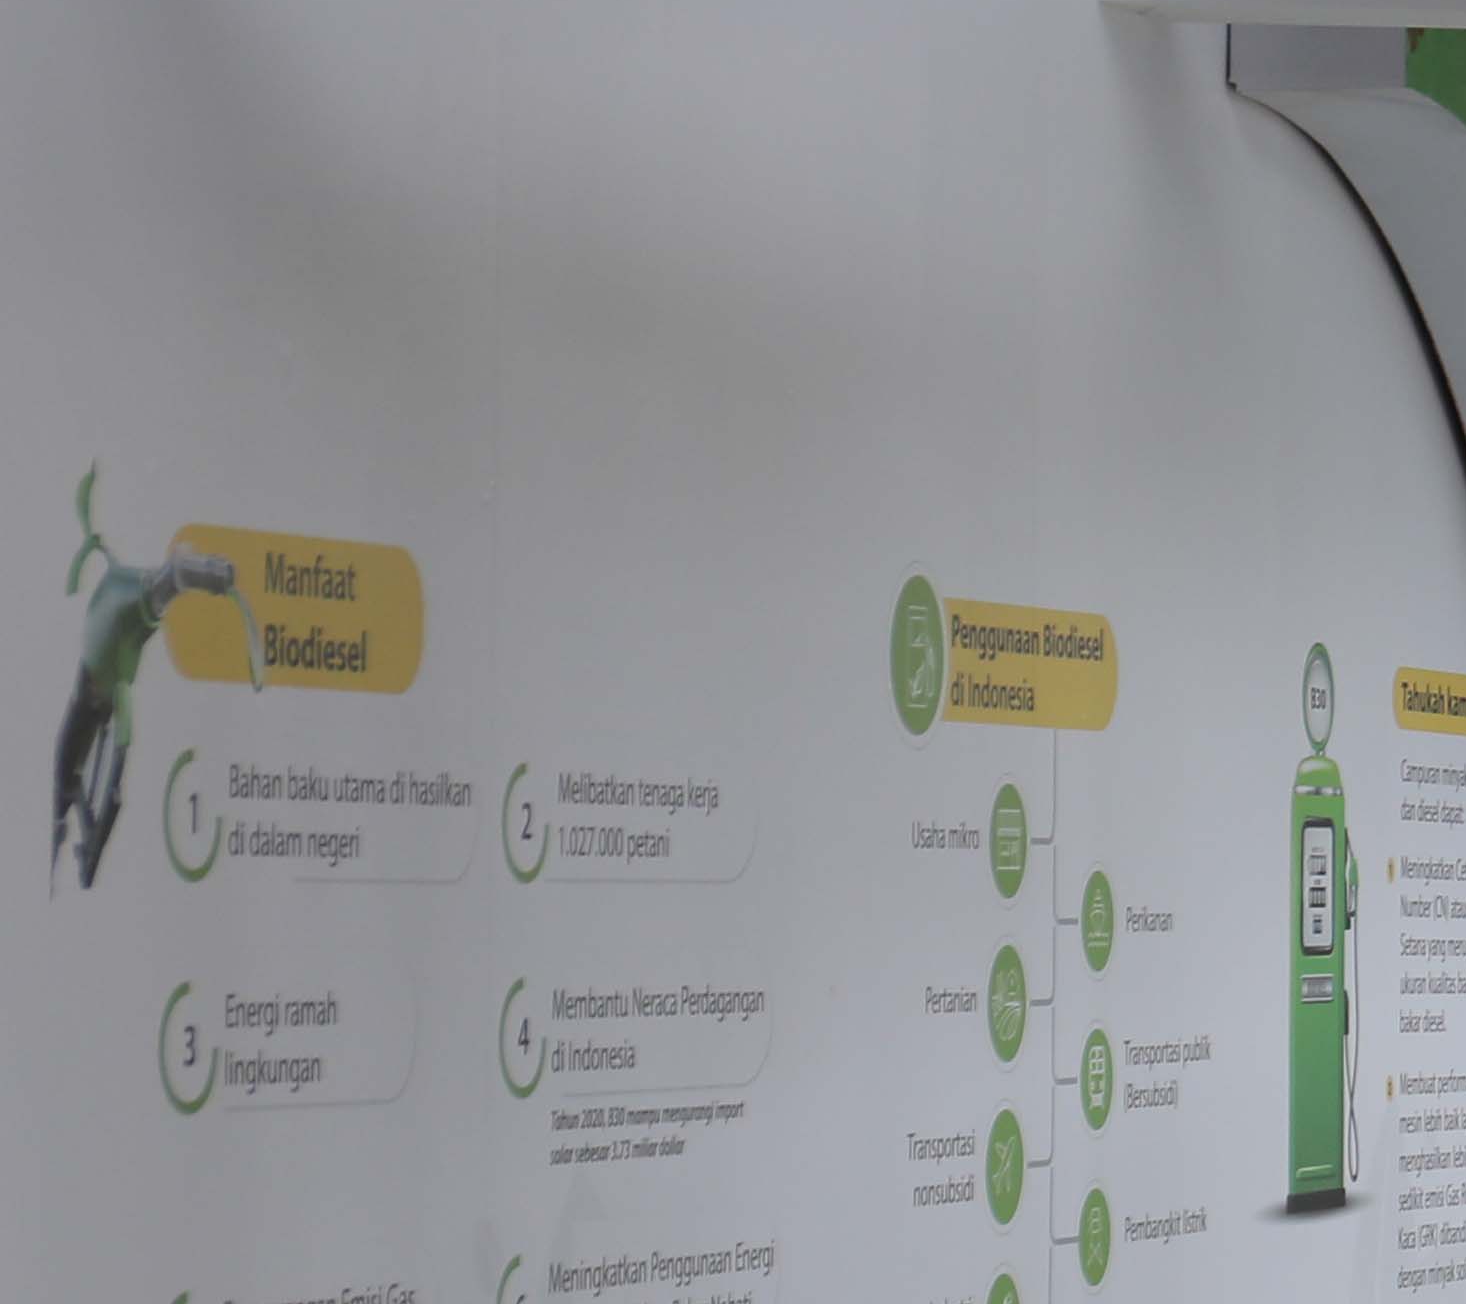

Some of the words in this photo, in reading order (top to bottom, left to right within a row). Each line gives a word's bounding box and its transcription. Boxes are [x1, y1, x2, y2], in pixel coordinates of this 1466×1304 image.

[265, 553, 357, 601] Manfaat
[263, 623, 367, 673] Biodiesel
[951, 614, 1040, 661] Penggunaan
[1043, 624, 1104, 662] Biodiesel
[951, 673, 965, 707] di
[968, 675, 1035, 712] Indonesia
[1400, 681, 1445, 716] Tahukah
[229, 763, 281, 799] Bahan
[288, 768, 329, 801] baku
[333, 776, 384, 804] utama
[390, 772, 405, 805] di
[410, 772, 471, 808] hasilkan
[558, 773, 634, 808] Melibatkan
[639, 777, 685, 816] tenaga
[687, 780, 719, 817] kerja
[189, 792, 200, 834] 1
[521, 802, 533, 840] 2
[228, 822, 243, 856] di
[250, 822, 301, 857] dalam
[307, 826, 359, 868] negeri
[558, 827, 624, 858] 1.027.000
[626, 827, 670, 865] petani
[911, 821, 946, 849] Usaha
[948, 822, 980, 850] mikro
[1126, 906, 1173, 934] Perikanan
[225, 993, 279, 1037] Energi
[284, 992, 337, 1028] ramah
[552, 987, 628, 1020] Membantu
[632, 989, 678, 1017] Neraca
[680, 984, 765, 1022] Perdagangan
[924, 986, 977, 1016] Pertanian
[185, 1025, 196, 1067] 3
[517, 1017, 530, 1055] 4
[1123, 1037, 1180, 1069] Transportasi
[1183, 1035, 1211, 1064] publik
[225, 1051, 321, 1095] lingkungan
[551, 1041, 566, 1073] di
[568, 1040, 636, 1072] Indonesia
[1124, 1079, 1177, 1113] (Bersubsidi)
[907, 1129, 975, 1167] Transportasi
[913, 1174, 974, 1208] nonsubsidi
[1124, 1214, 1181, 1246] Pembangkit
[1183, 1207, 1207, 1235] listrik
[548, 1257, 647, 1297] Meningkatkan
[651, 1250, 732, 1288] Penggunaan
[735, 1240, 775, 1277] Energi
